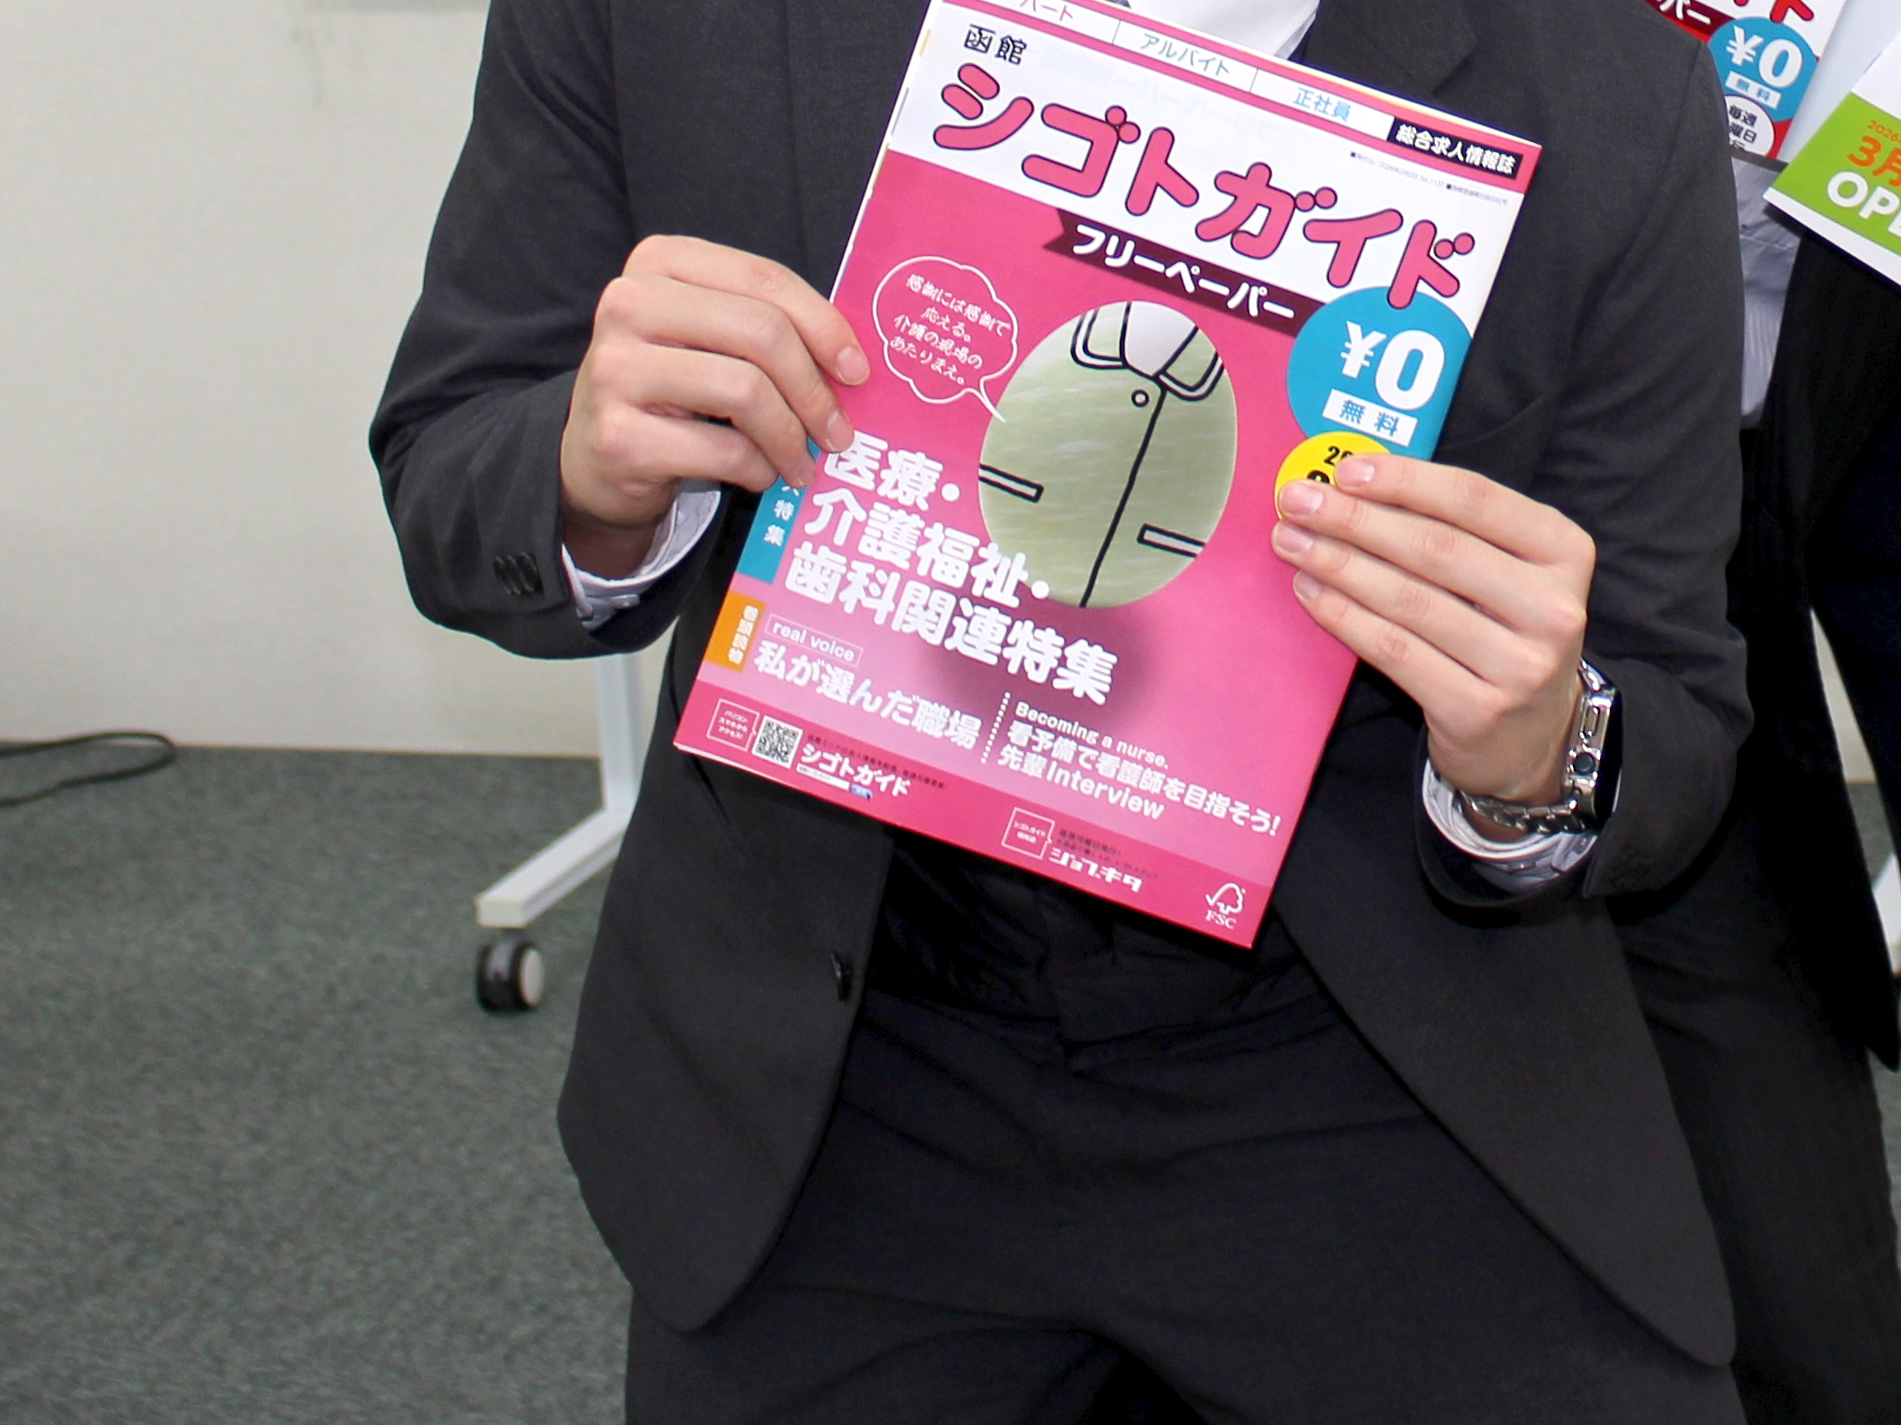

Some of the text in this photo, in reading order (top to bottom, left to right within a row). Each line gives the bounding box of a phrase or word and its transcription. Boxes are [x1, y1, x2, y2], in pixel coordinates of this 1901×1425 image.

[964, 24, 1027, 64] 函館
[1725, 24, 1803, 88] ¥0
[1140, 33, 1230, 76] アルバイト
[1293, 86, 1352, 122] 正社員
[1395, 124, 1516, 175] 総合求人情報誌
[1729, 104, 1757, 127] 毎週
[1735, 78, 1771, 101] 無料
[933, 63, 1475, 309] シゴトガイド
[1073, 224, 1295, 318] フリーペーパー
[894, 314, 982, 369] 介護の現場の
[921, 307, 971, 342] 応える。
[890, 336, 965, 385] あたりまえ。
[1340, 320, 1445, 411] ¥0
[1339, 399, 1399, 436] 無料
[824, 430, 961, 511] 医療・
[803, 487, 1051, 609] 介護福祉・
[772, 621, 855, 662] real voice
[784, 541, 1118, 706] 歯科関連特集
[753, 639, 982, 751] 私が選んだ職場
[1015, 701, 1169, 769] Becoming a nurse.
[800, 742, 911, 797] シゴトガイド
[997, 743, 1165, 820] 先輩Interview
[1007, 719, 1282, 837] 看予備で看護師を目指そう!
[1049, 847, 1143, 893] ジョブキタ
[1204, 908, 1238, 930] FSC
